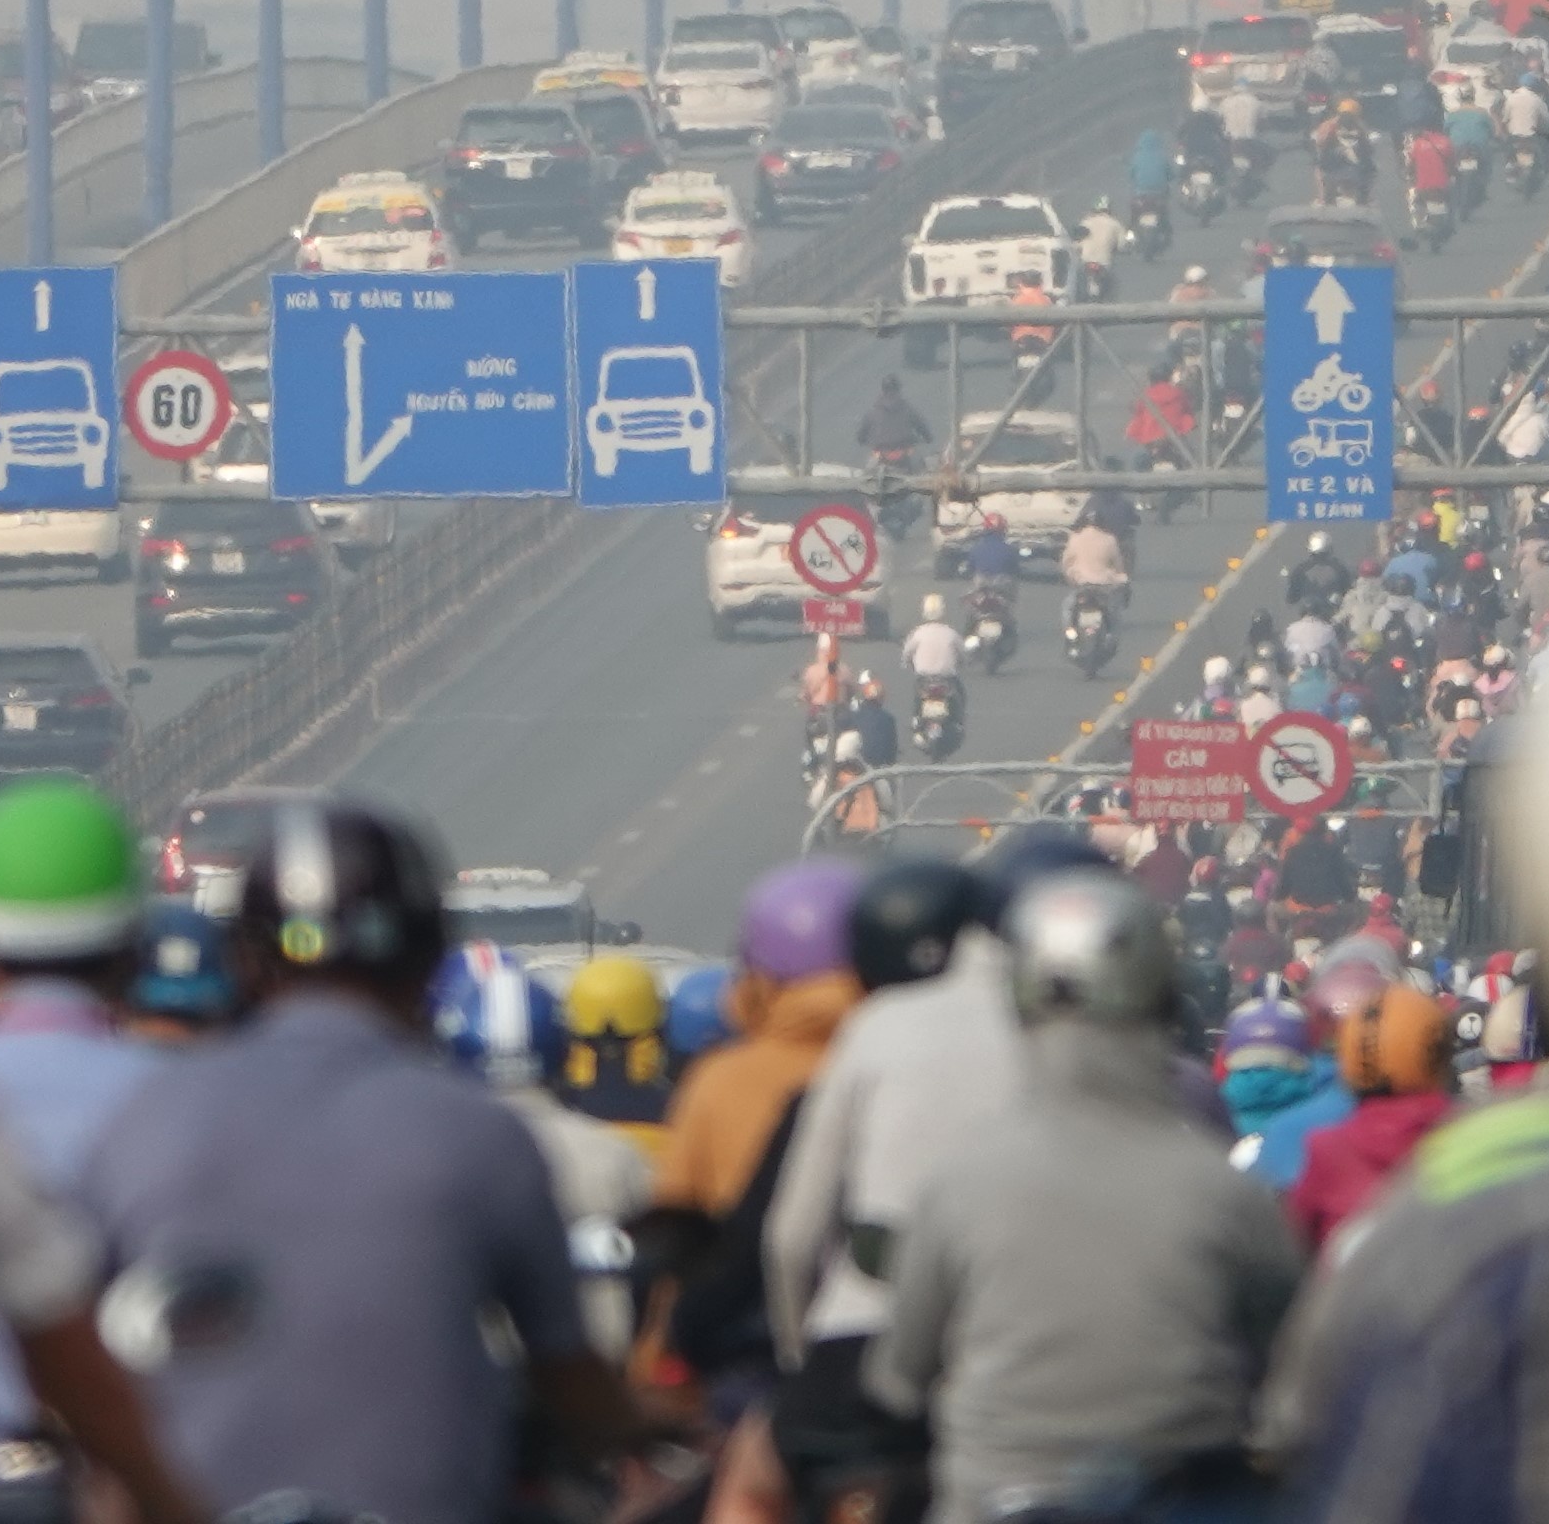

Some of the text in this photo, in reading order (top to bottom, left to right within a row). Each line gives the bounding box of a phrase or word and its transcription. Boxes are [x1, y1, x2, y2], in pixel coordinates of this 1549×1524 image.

[153, 383, 203, 430] 60
[1287, 473, 1375, 495] XE 2 VÀ
